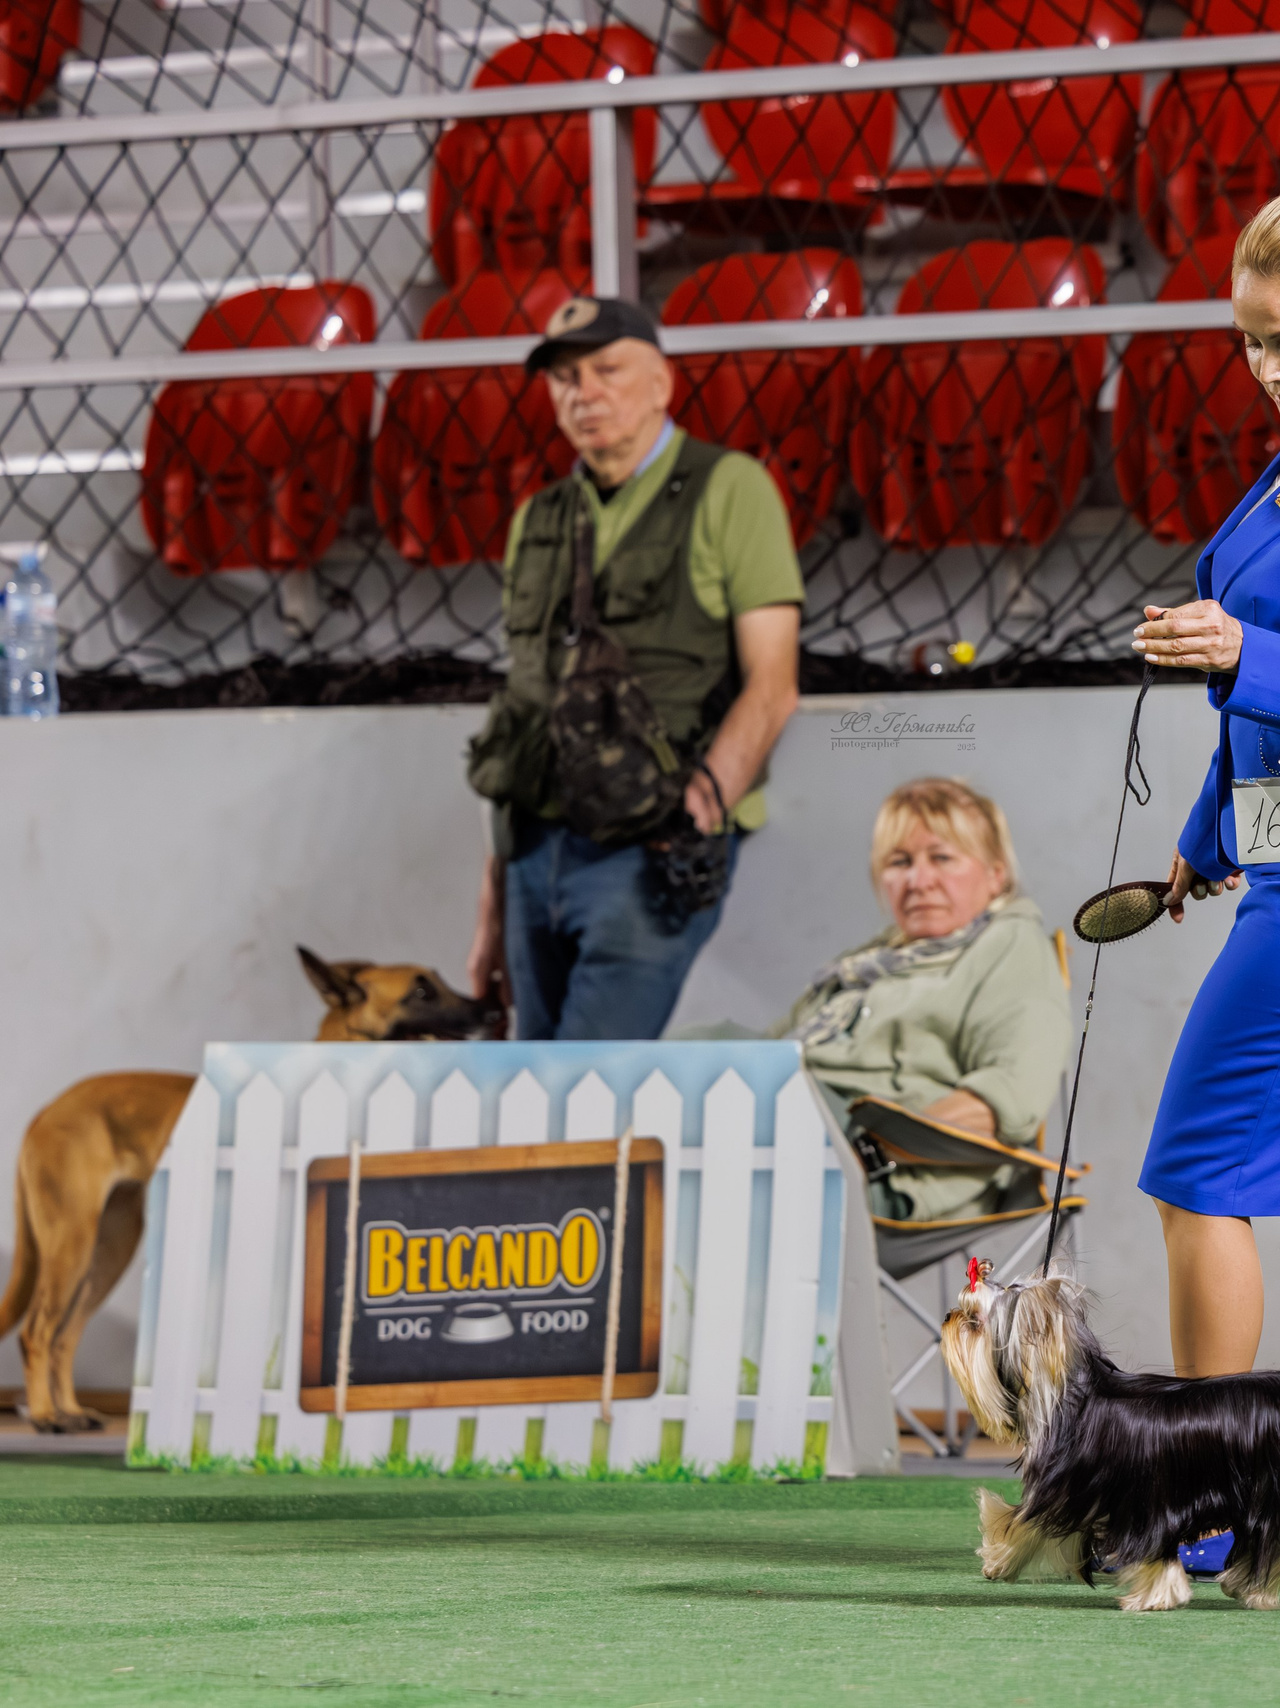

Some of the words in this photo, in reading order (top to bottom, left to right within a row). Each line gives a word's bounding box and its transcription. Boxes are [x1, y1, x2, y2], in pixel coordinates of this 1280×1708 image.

[364, 1211, 603, 1300] BELCANDO
[377, 1317, 432, 1342] DOG
[520, 1309, 589, 1334] FOOD
